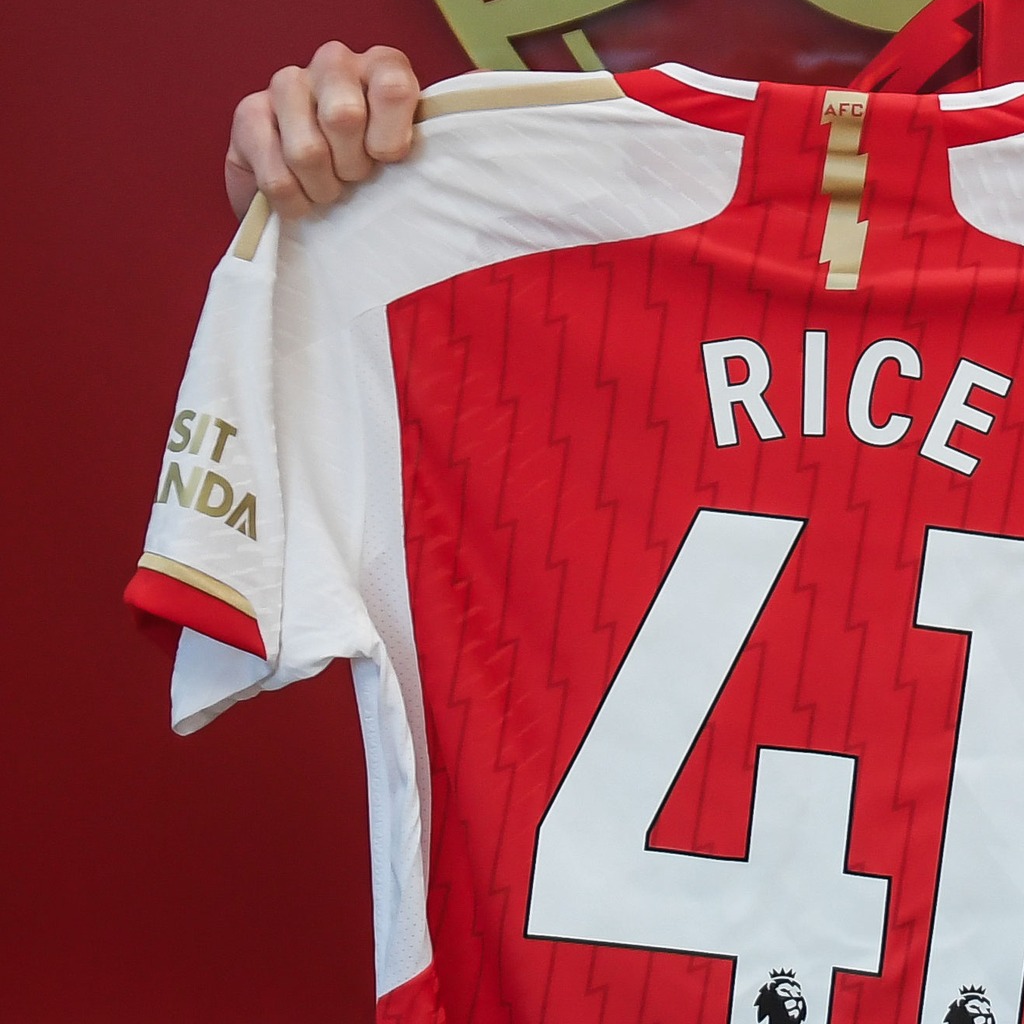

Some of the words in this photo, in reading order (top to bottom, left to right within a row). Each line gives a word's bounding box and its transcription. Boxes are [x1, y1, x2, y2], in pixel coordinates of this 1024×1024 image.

[824, 103, 864, 117] AFC
[701, 329, 1013, 476] RICE
[154, 461, 257, 541] NDA
